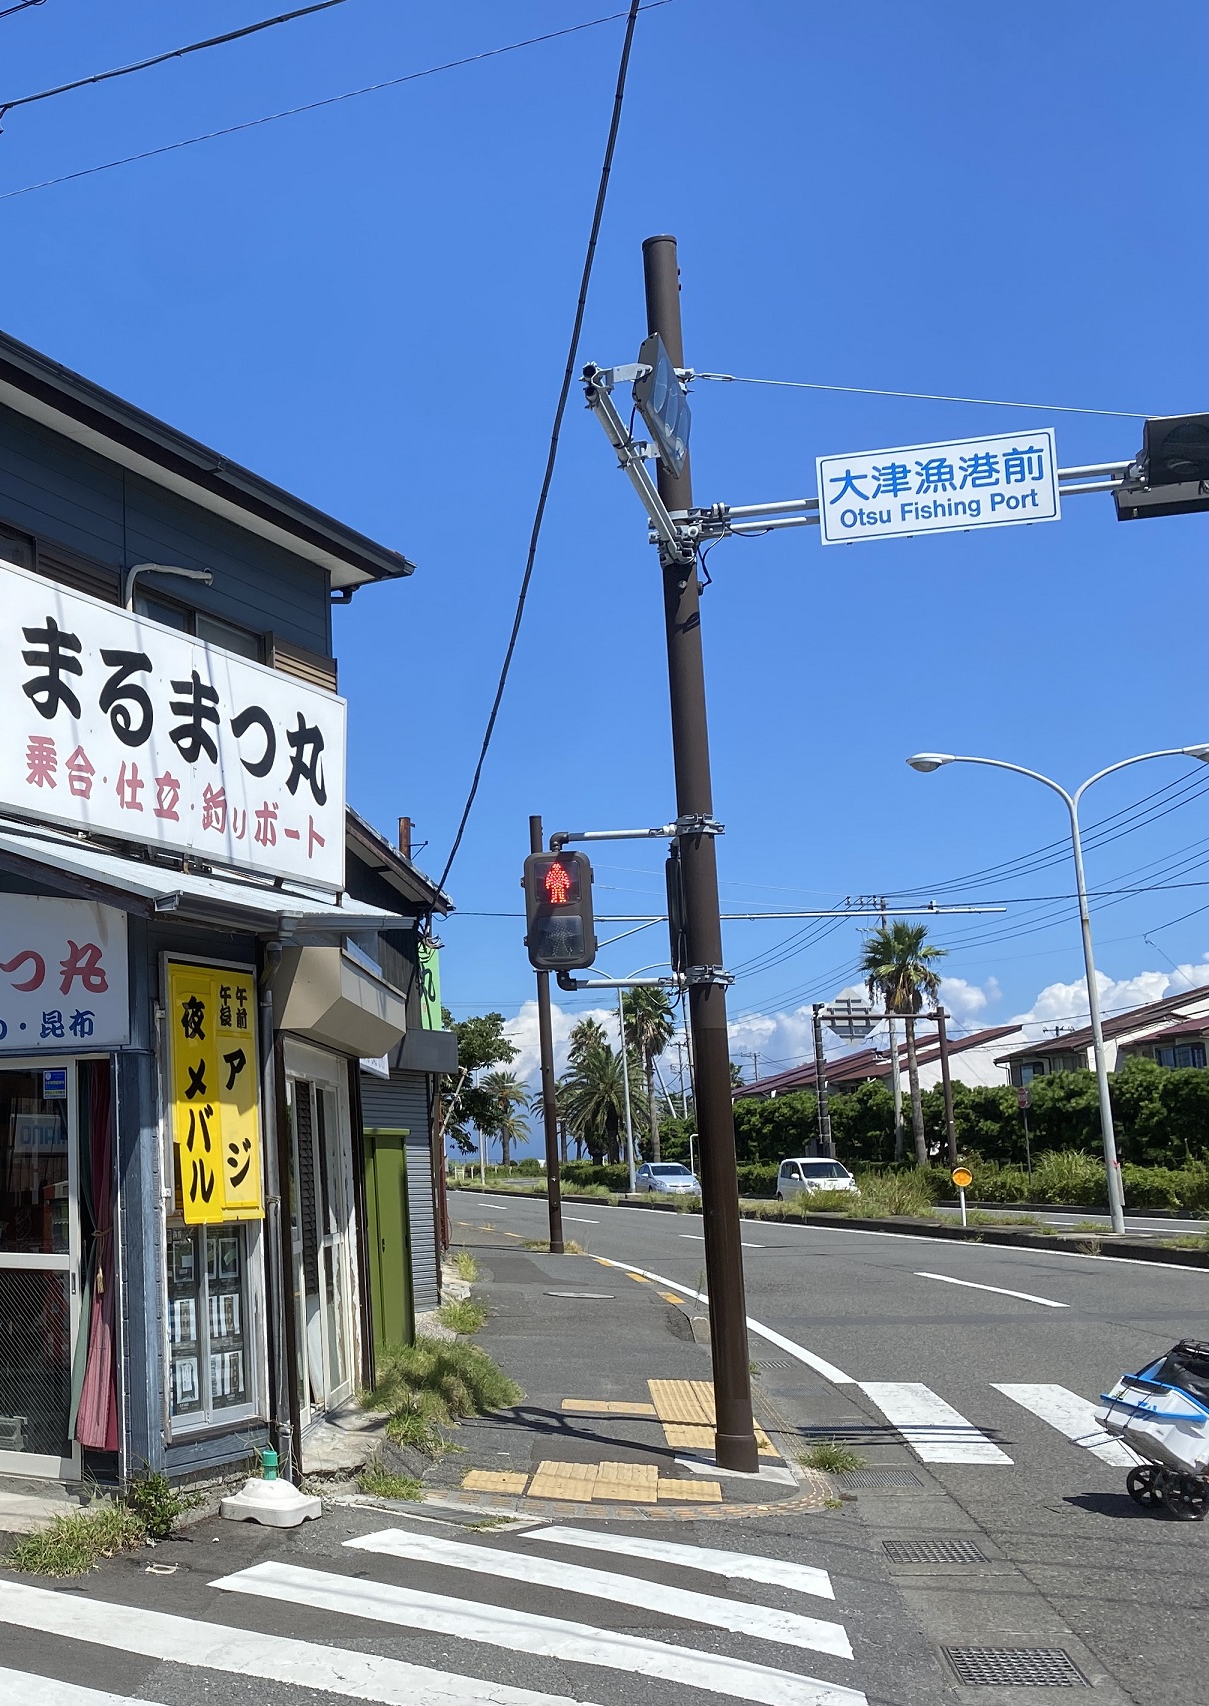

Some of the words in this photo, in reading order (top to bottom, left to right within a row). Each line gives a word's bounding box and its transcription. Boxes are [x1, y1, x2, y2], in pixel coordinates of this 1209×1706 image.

[829, 446, 1044, 505] 大津漁港前
[840, 509, 891, 529] Otsu
[900, 498, 981, 521] Fishing
[990, 489, 1039, 511] Port
[22, 617, 327, 806] まるまつ丸
[180, 995, 214, 1203] 夜メバル
[223, 1048, 251, 1188] アジ
